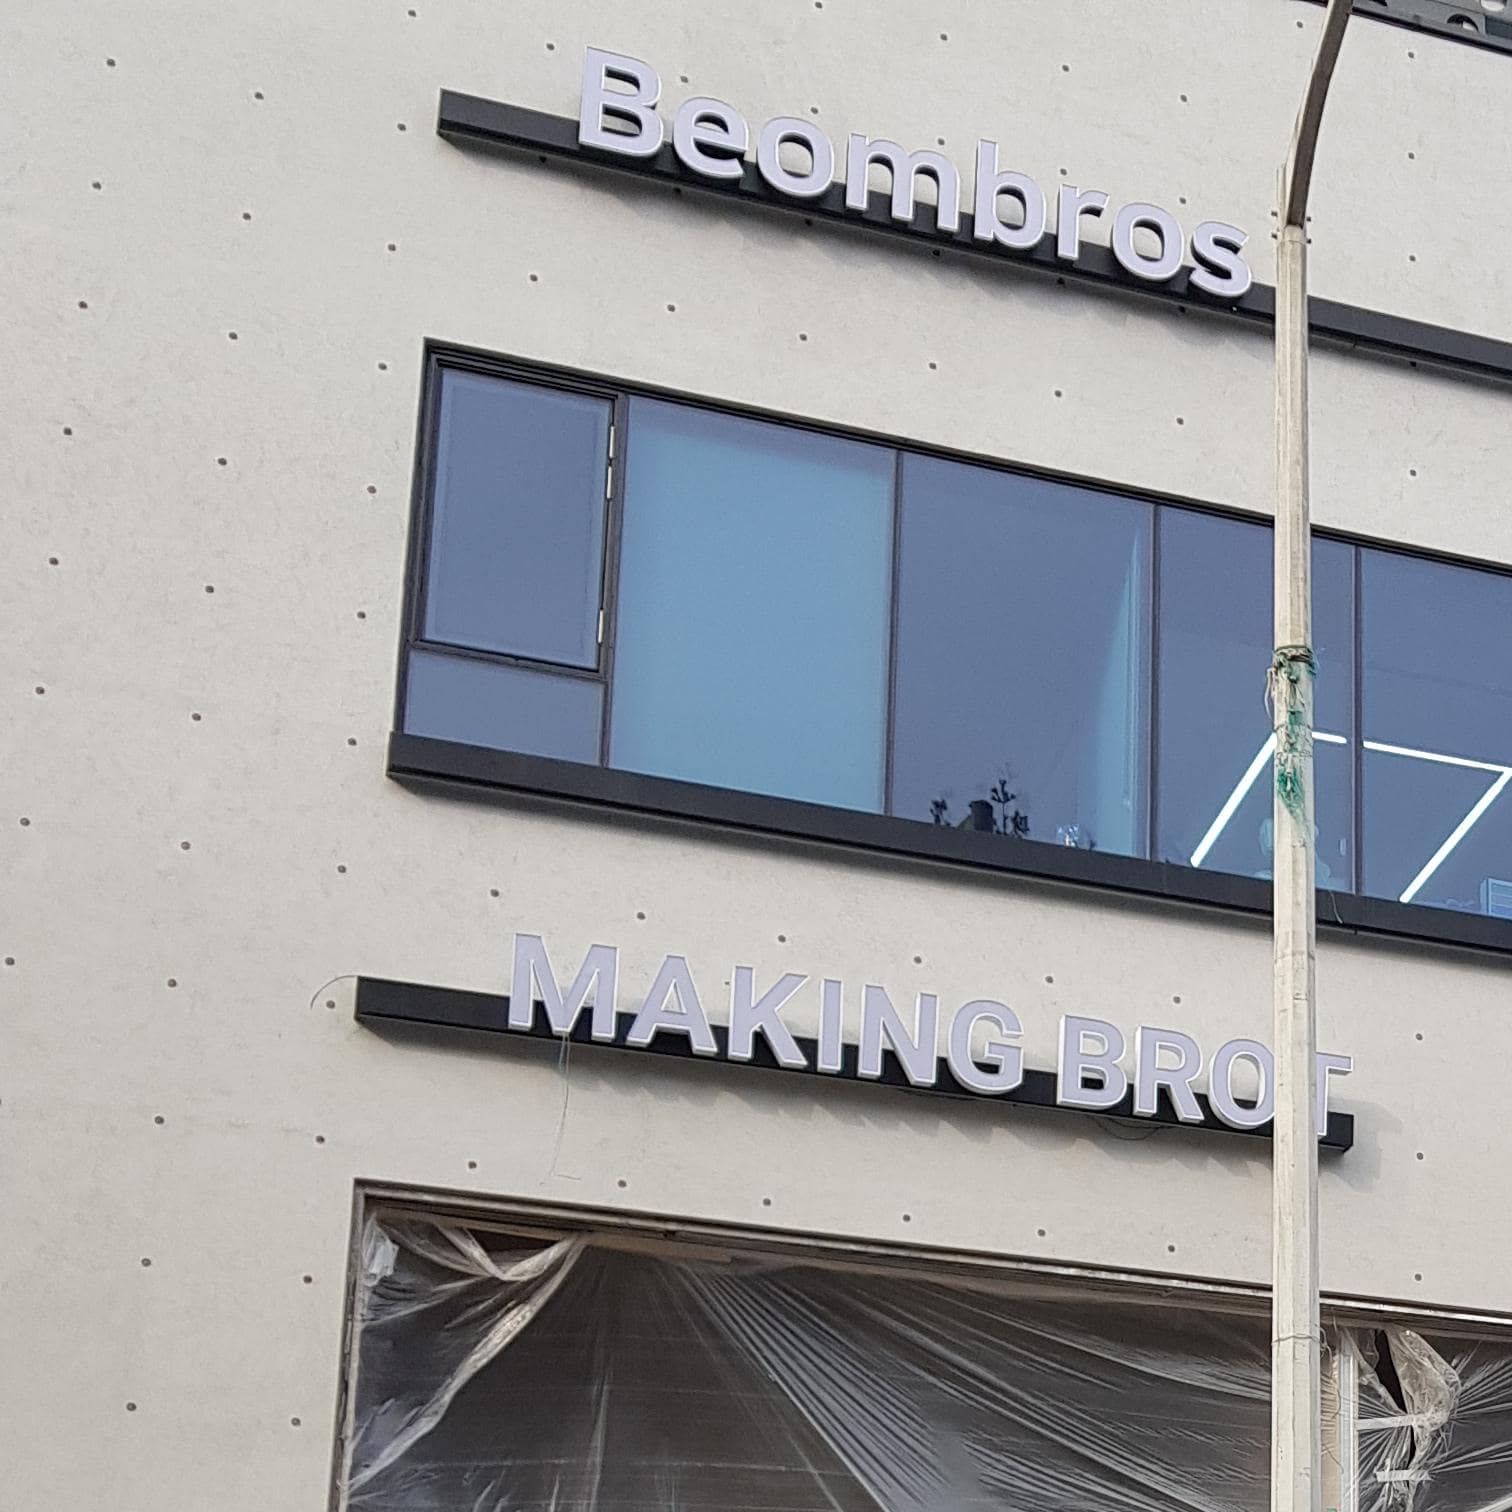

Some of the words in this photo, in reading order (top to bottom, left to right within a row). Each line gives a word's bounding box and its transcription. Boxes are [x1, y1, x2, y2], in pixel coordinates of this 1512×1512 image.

[578, 45, 1253, 299] Beombros
[507, 932, 1025, 1095] MAKING
[1056, 1013, 1355, 1138] BROT
